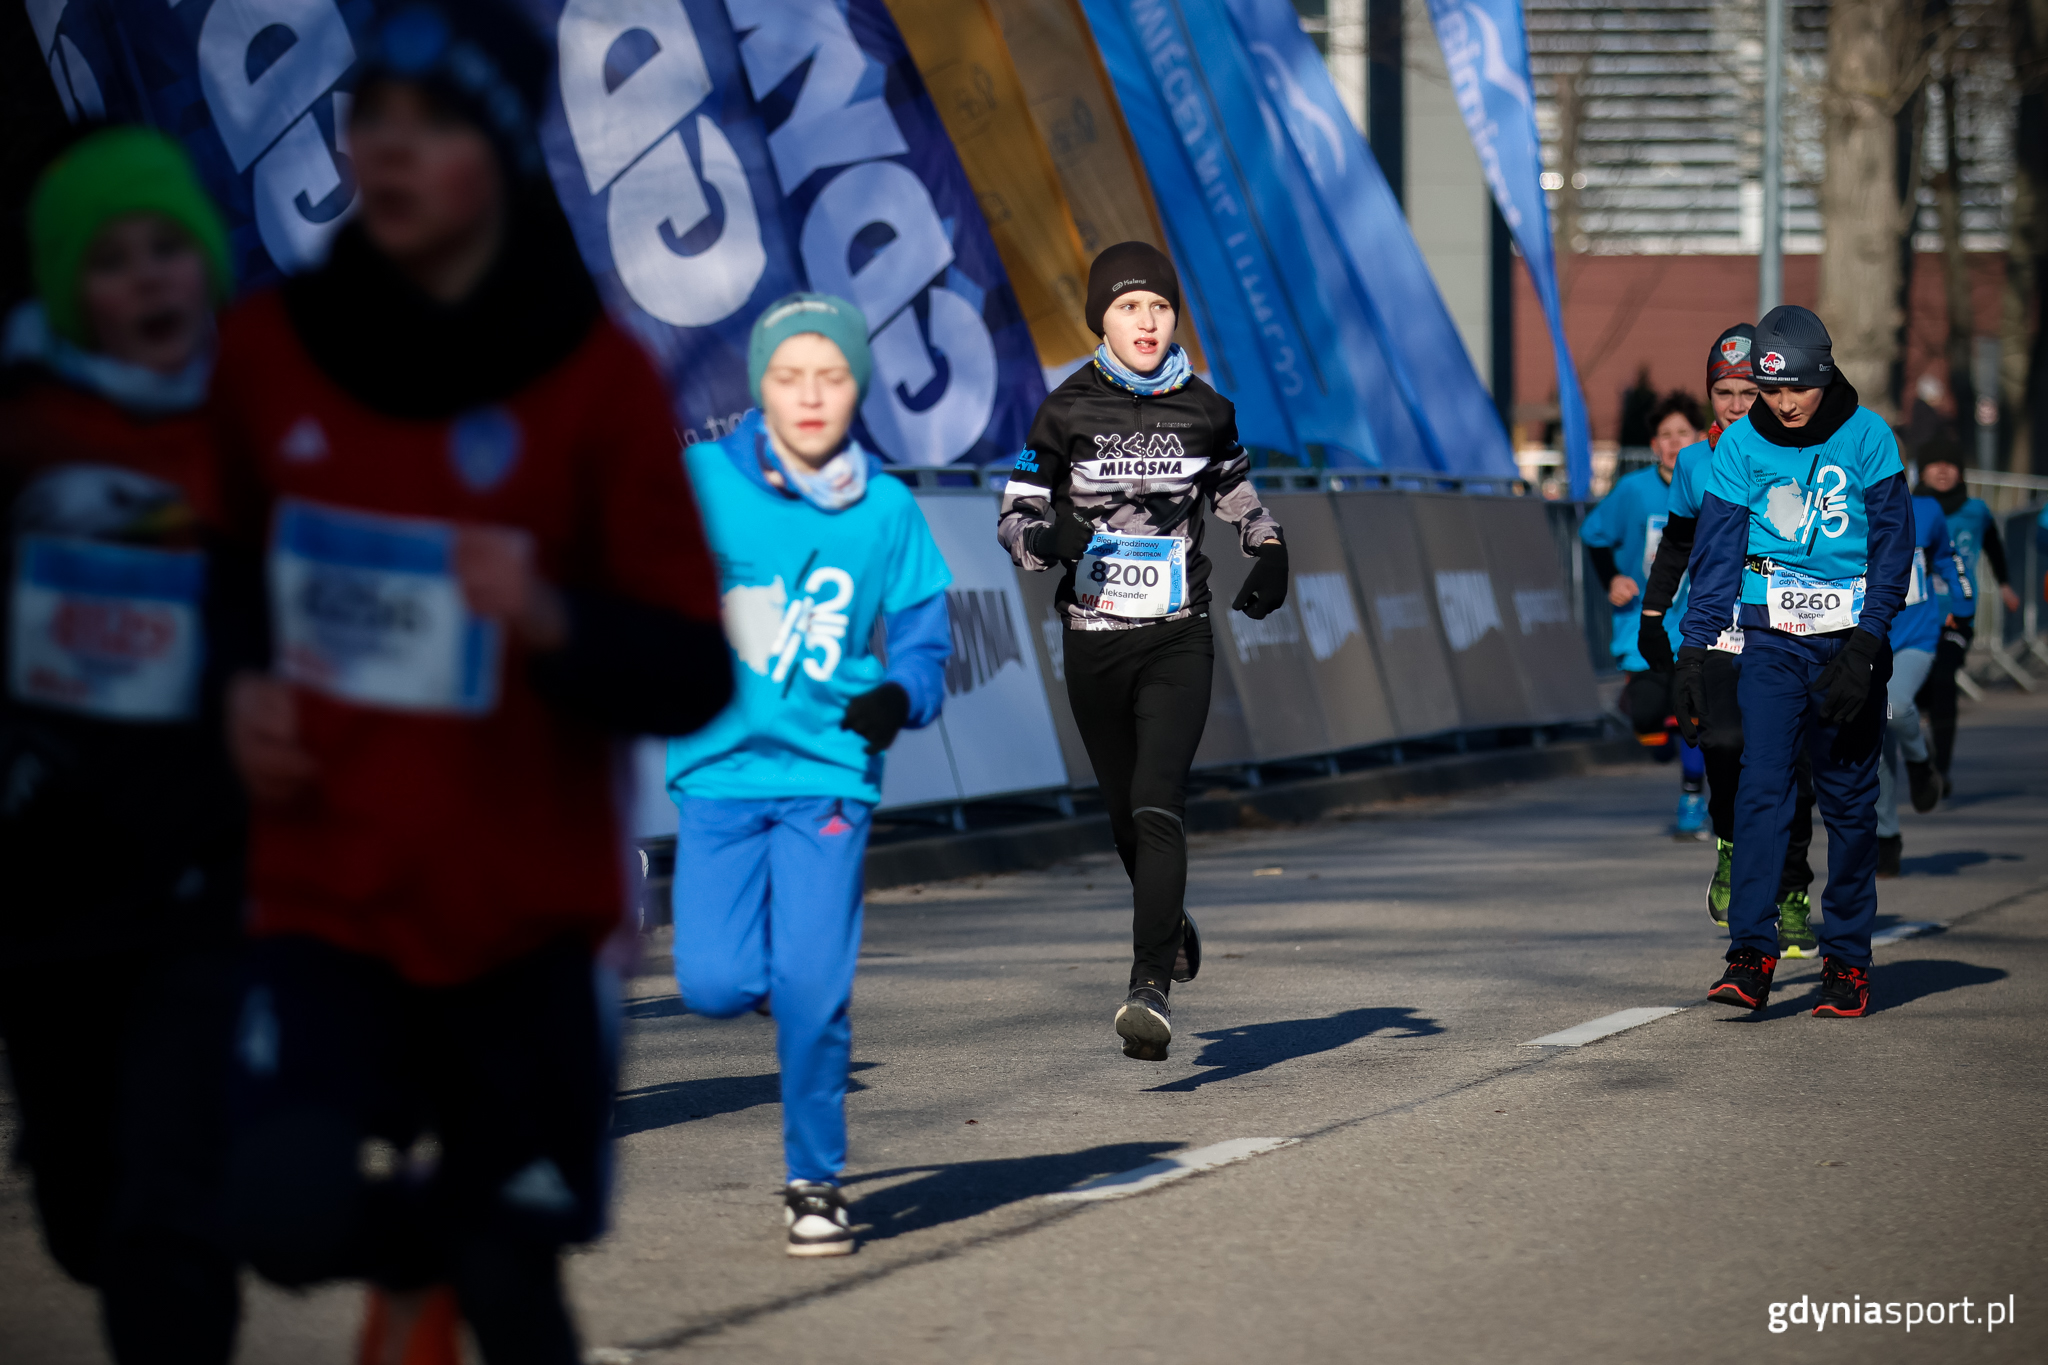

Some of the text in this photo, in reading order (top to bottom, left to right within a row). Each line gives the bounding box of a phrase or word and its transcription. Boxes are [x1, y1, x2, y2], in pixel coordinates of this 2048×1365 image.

[1098, 461, 1183, 477] MIŁOSNA
[1096, 536, 1160, 549] Bieg Urodzinowy
[1092, 545, 1113, 555] Gdyni
[1090, 560, 1159, 588] 8200
[1099, 588, 1149, 600] Aleksander
[1780, 591, 1841, 611] 8260
[1081, 593, 1115, 611] MŁm
[1797, 612, 1825, 620] Kacper
